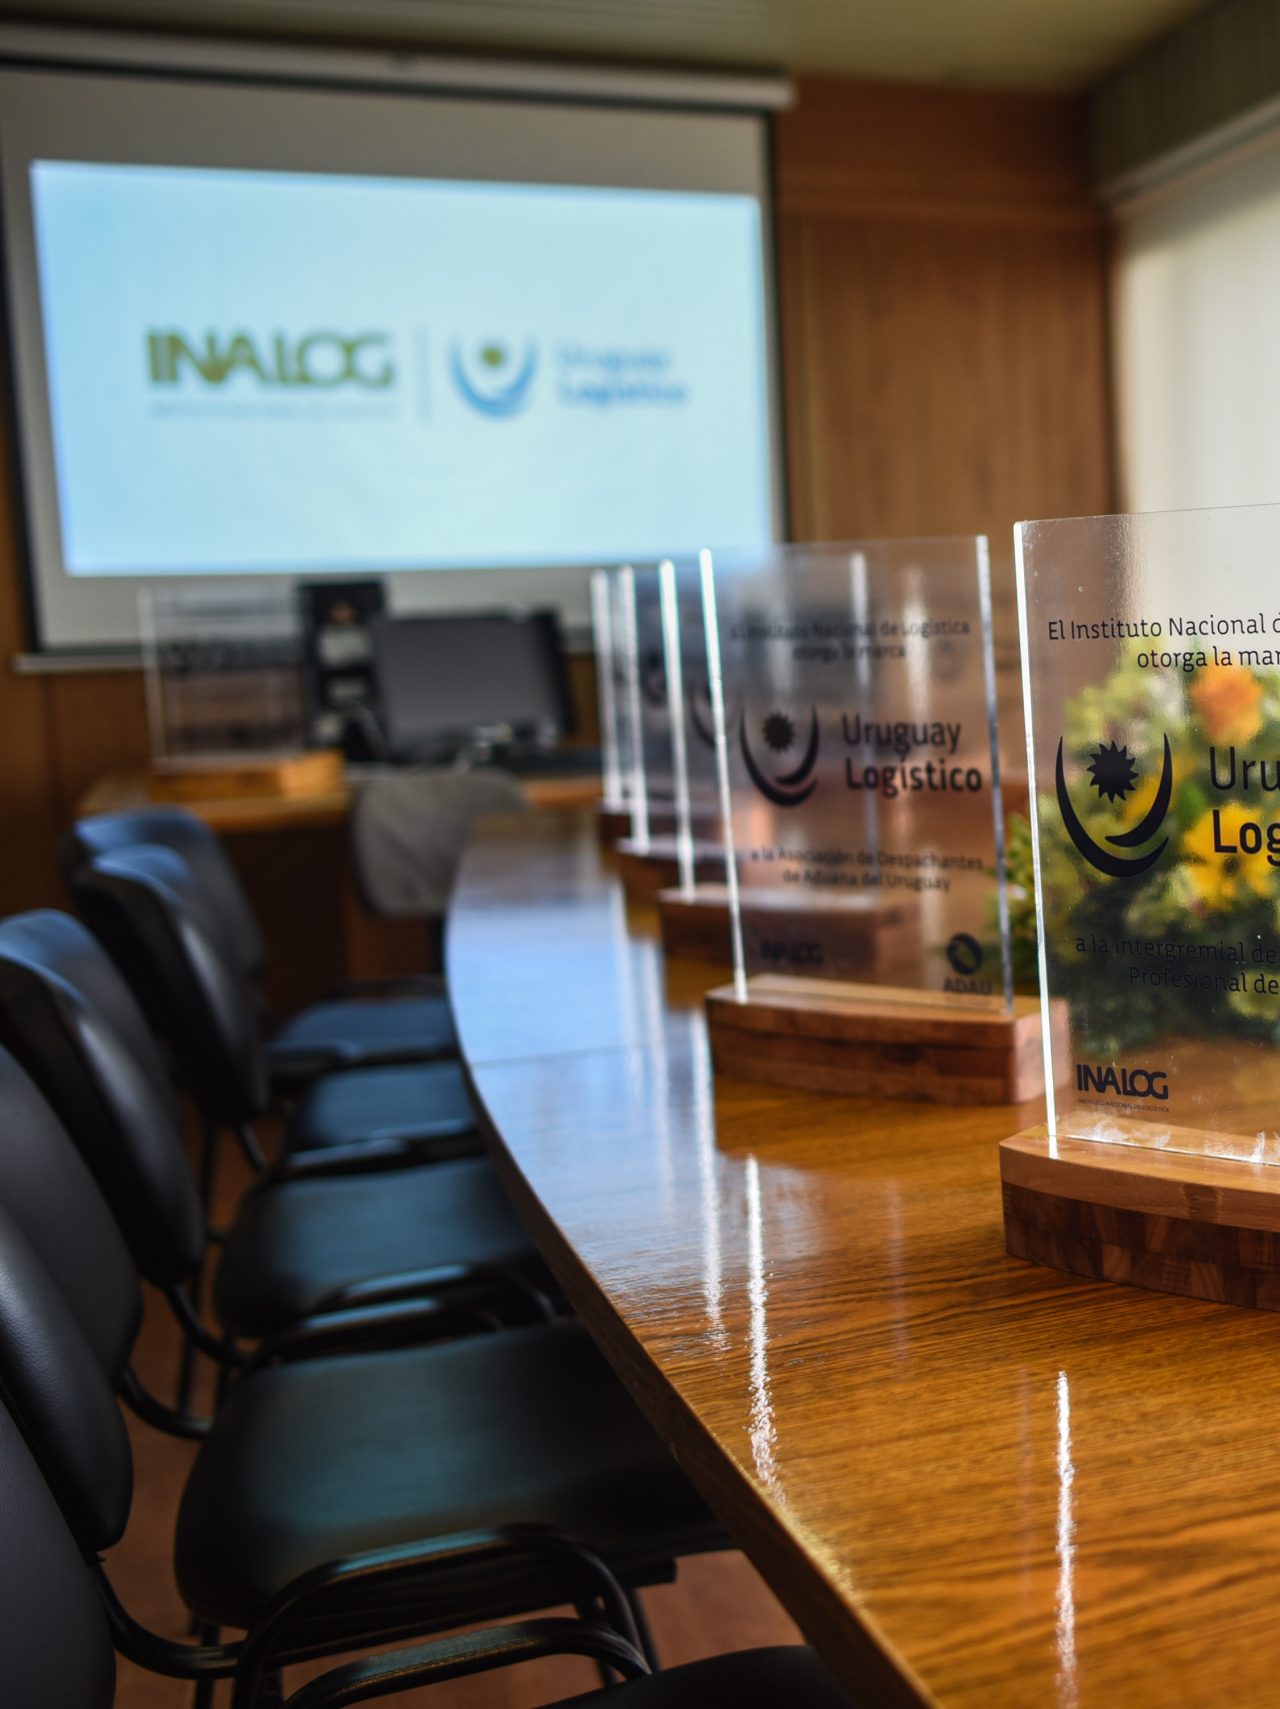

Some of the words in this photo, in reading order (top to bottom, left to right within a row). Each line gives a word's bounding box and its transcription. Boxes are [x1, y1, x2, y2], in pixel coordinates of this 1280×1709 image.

[147, 331, 394, 388] INALOG
[880, 620, 899, 634] de
[1048, 620, 1066, 640] El
[1071, 617, 1162, 640] Instituto
[1168, 612, 1264, 636] Nacional
[1137, 648, 1207, 672] otorga
[1213, 646, 1232, 666] la
[842, 713, 961, 756] Uruguay
[847, 756, 983, 799] Logístico
[1076, 938, 1086, 952] a
[1090, 934, 1108, 954] la
[1116, 936, 1245, 965] Intergremial
[1252, 944, 1277, 964] de
[1130, 967, 1248, 993] Profesional
[1254, 974, 1278, 994] de
[1077, 1064, 1168, 1100] INALOG
